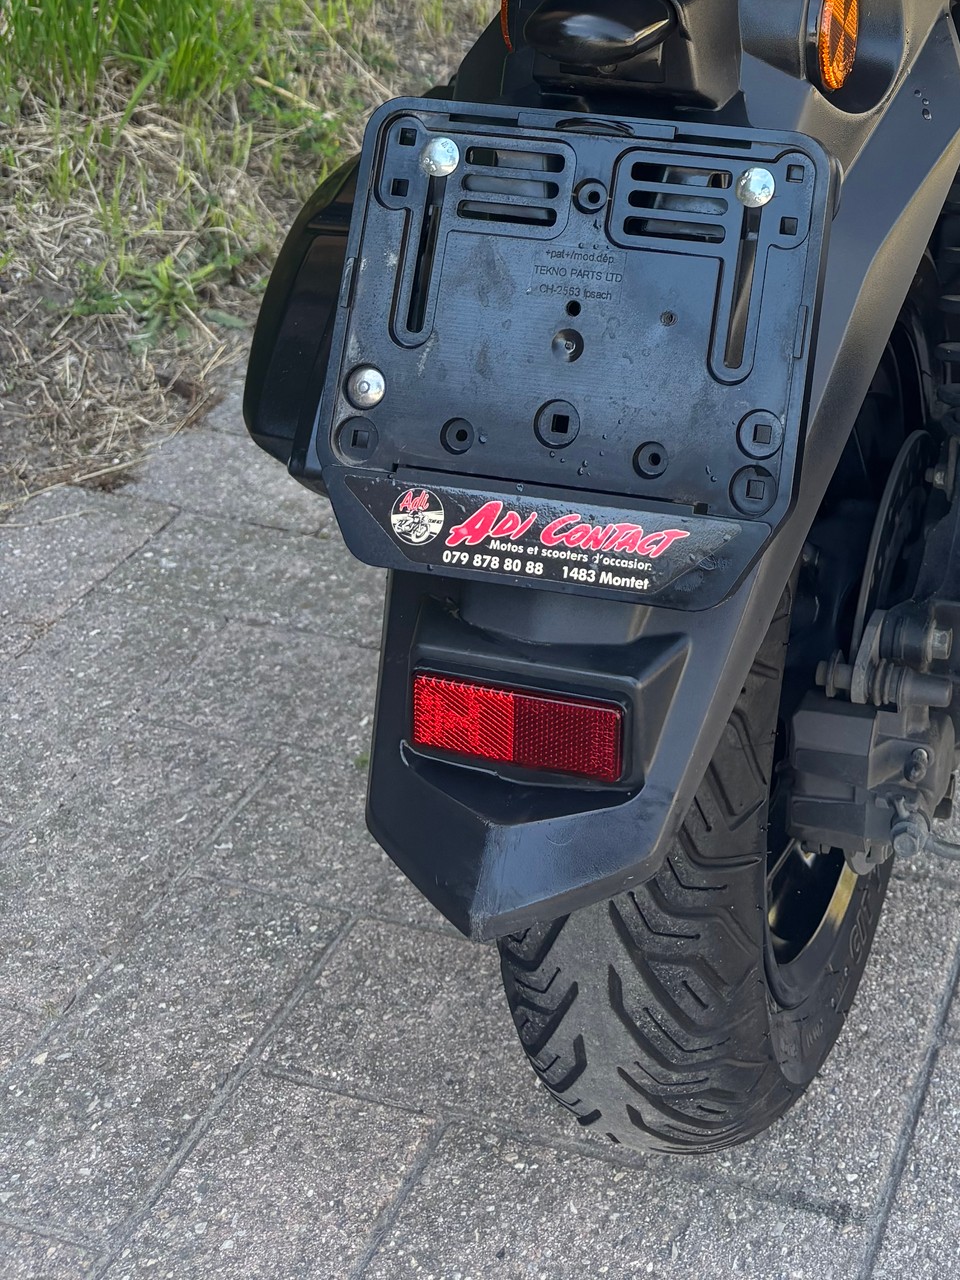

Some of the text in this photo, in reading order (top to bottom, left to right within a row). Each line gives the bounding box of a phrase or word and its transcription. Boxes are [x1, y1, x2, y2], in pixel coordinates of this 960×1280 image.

[534, 265, 623, 283] TEKNO PARTS LTD
[399, 490, 430, 512] Adi
[488, 539, 524, 554] Motos
[526, 545, 539, 556] et
[541, 547, 589, 563] scooters
[442, 550, 650, 590] 079 878 80 88 1483 Montet
